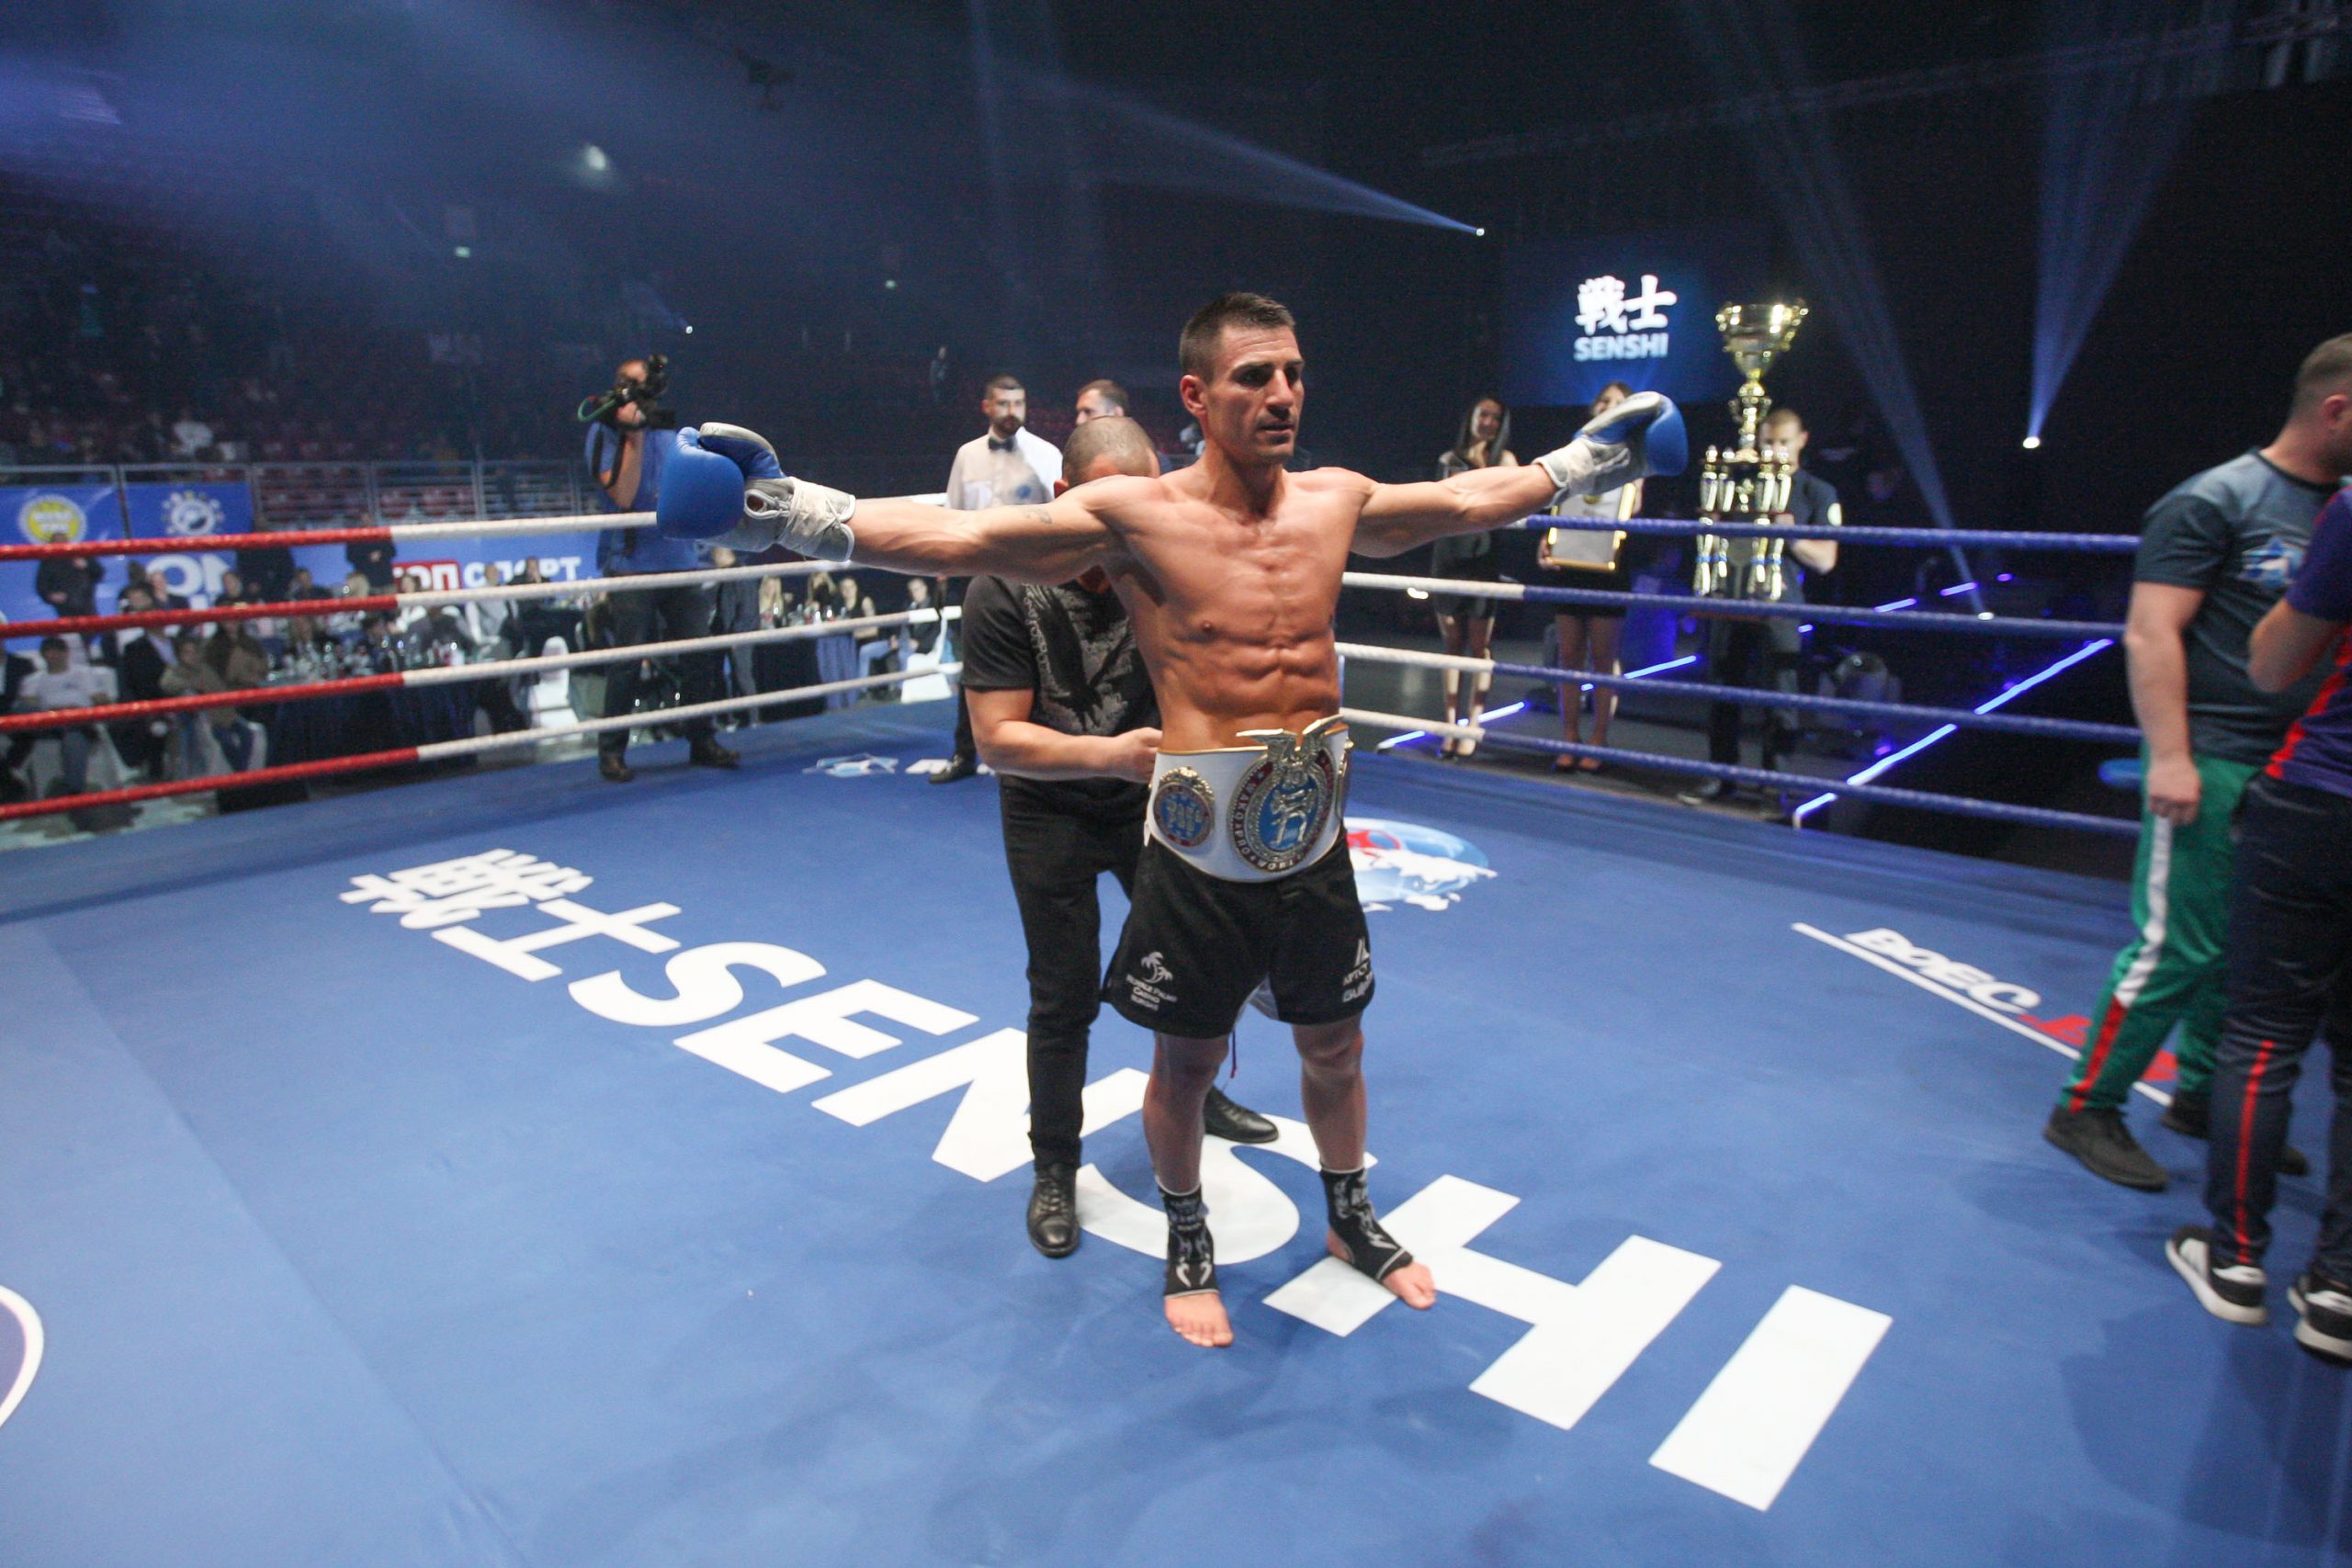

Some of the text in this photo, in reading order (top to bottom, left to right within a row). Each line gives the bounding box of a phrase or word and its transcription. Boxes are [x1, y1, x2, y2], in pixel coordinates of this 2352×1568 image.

[1574, 333, 1668, 361] SENSHI
[464, 557, 581, 588] СПРТ
[568, 942, 1894, 1511] SENSHI
